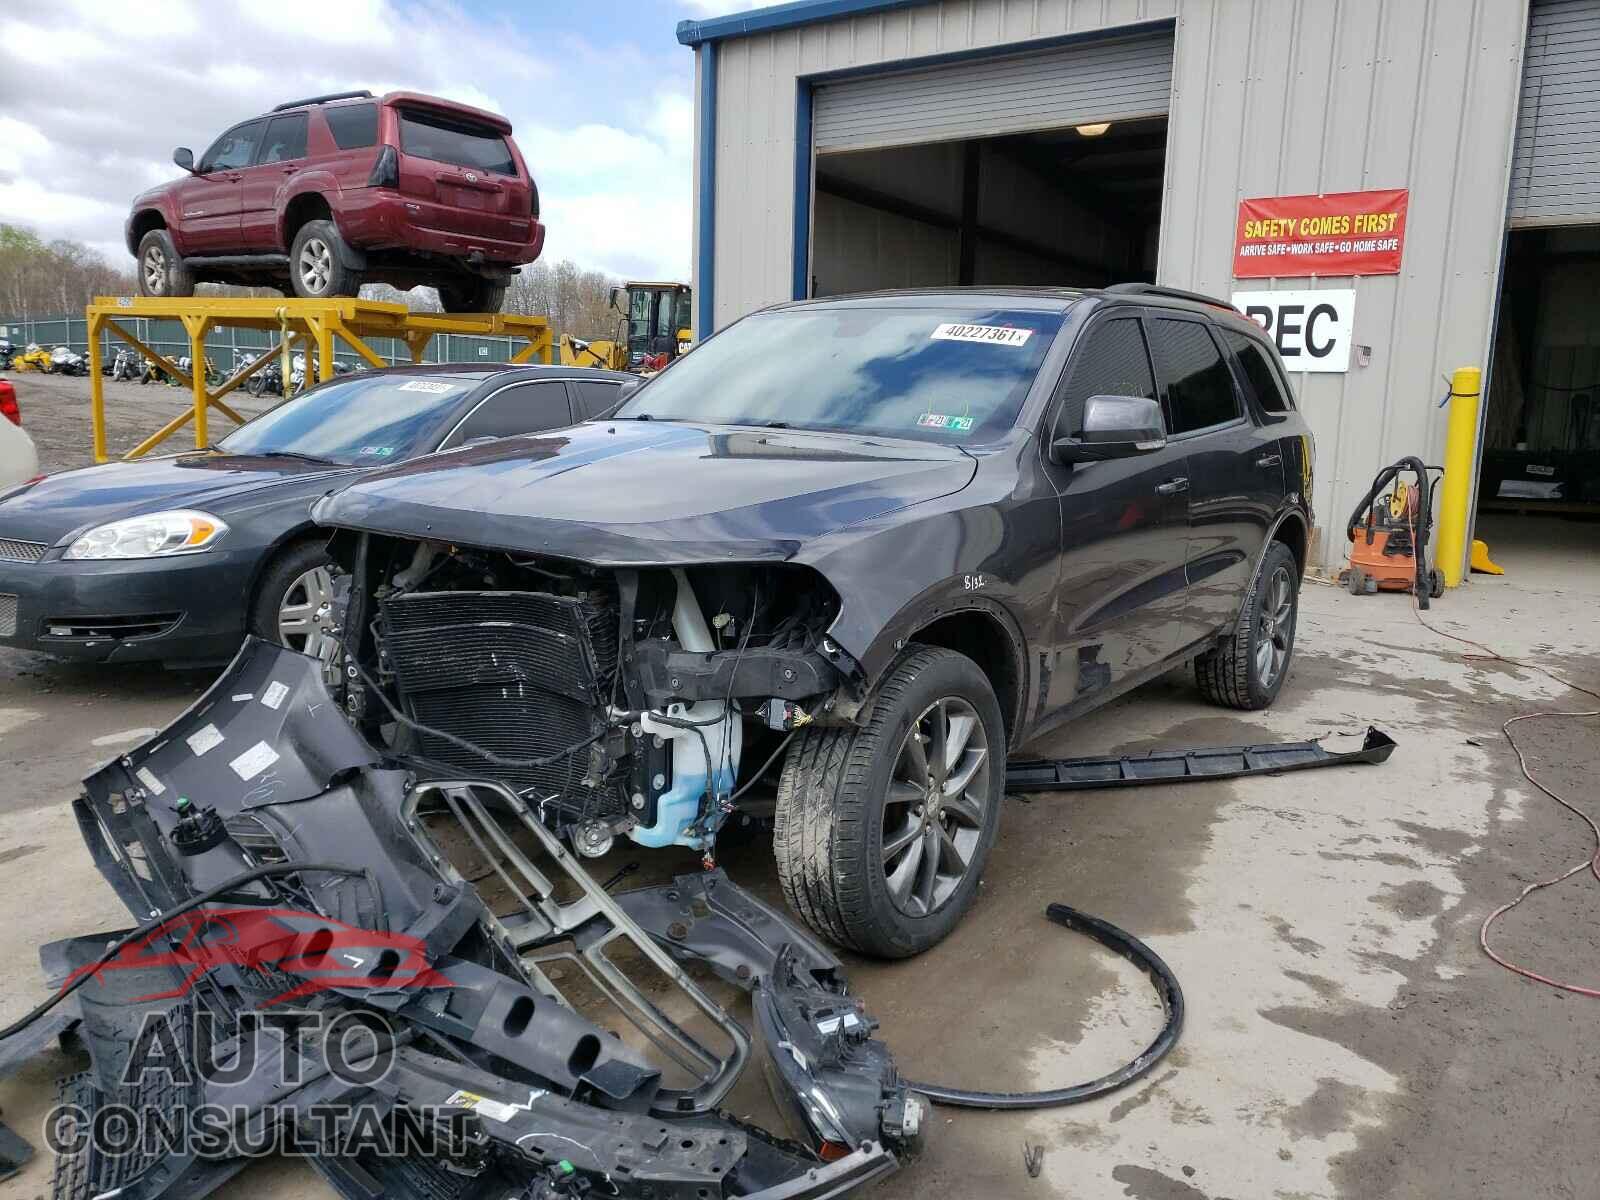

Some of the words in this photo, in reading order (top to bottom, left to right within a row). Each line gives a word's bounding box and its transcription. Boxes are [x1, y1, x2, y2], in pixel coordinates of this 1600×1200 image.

[1244, 218, 1297, 239] SAFETY
[1300, 215, 1350, 236] COMES
[1354, 212, 1398, 233] FIRST
[1240, 244, 1267, 257] ARRIVE
[1267, 243, 1287, 255] SAFE
[1290, 242, 1314, 254] WORK
[1315, 241, 1336, 253] SAFE
[1339, 240, 1351, 252] GO
[1353, 239, 1376, 252] HOME
[1377, 238, 1399, 250] SAFE
